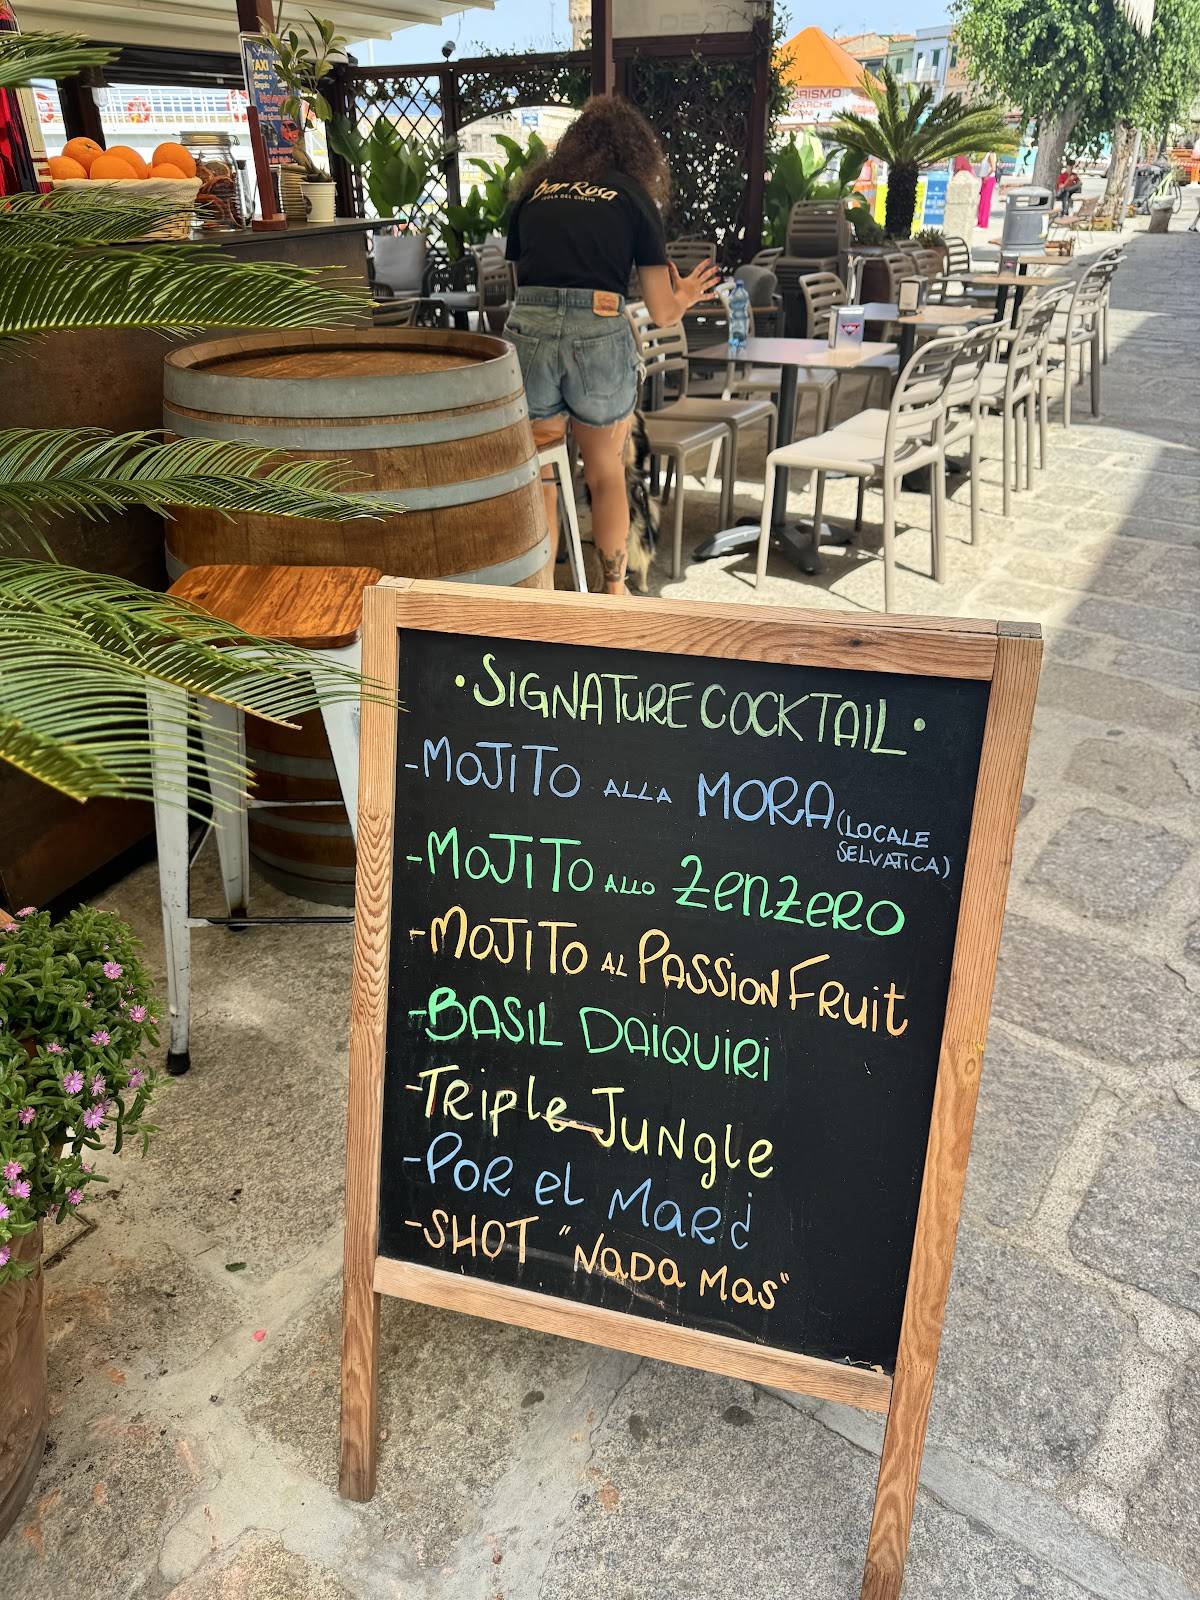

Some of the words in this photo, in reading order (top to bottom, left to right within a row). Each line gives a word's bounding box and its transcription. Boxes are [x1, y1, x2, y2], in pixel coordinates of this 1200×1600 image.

[700, 683, 908, 757] COCKTAIL
[602, 778, 673, 804] ALLA
[697, 771, 835, 830] MORA
[836, 808, 931, 849] (LOCALE
[603, 873, 656, 896] ALLO
[600, 951, 629, 978] AL
